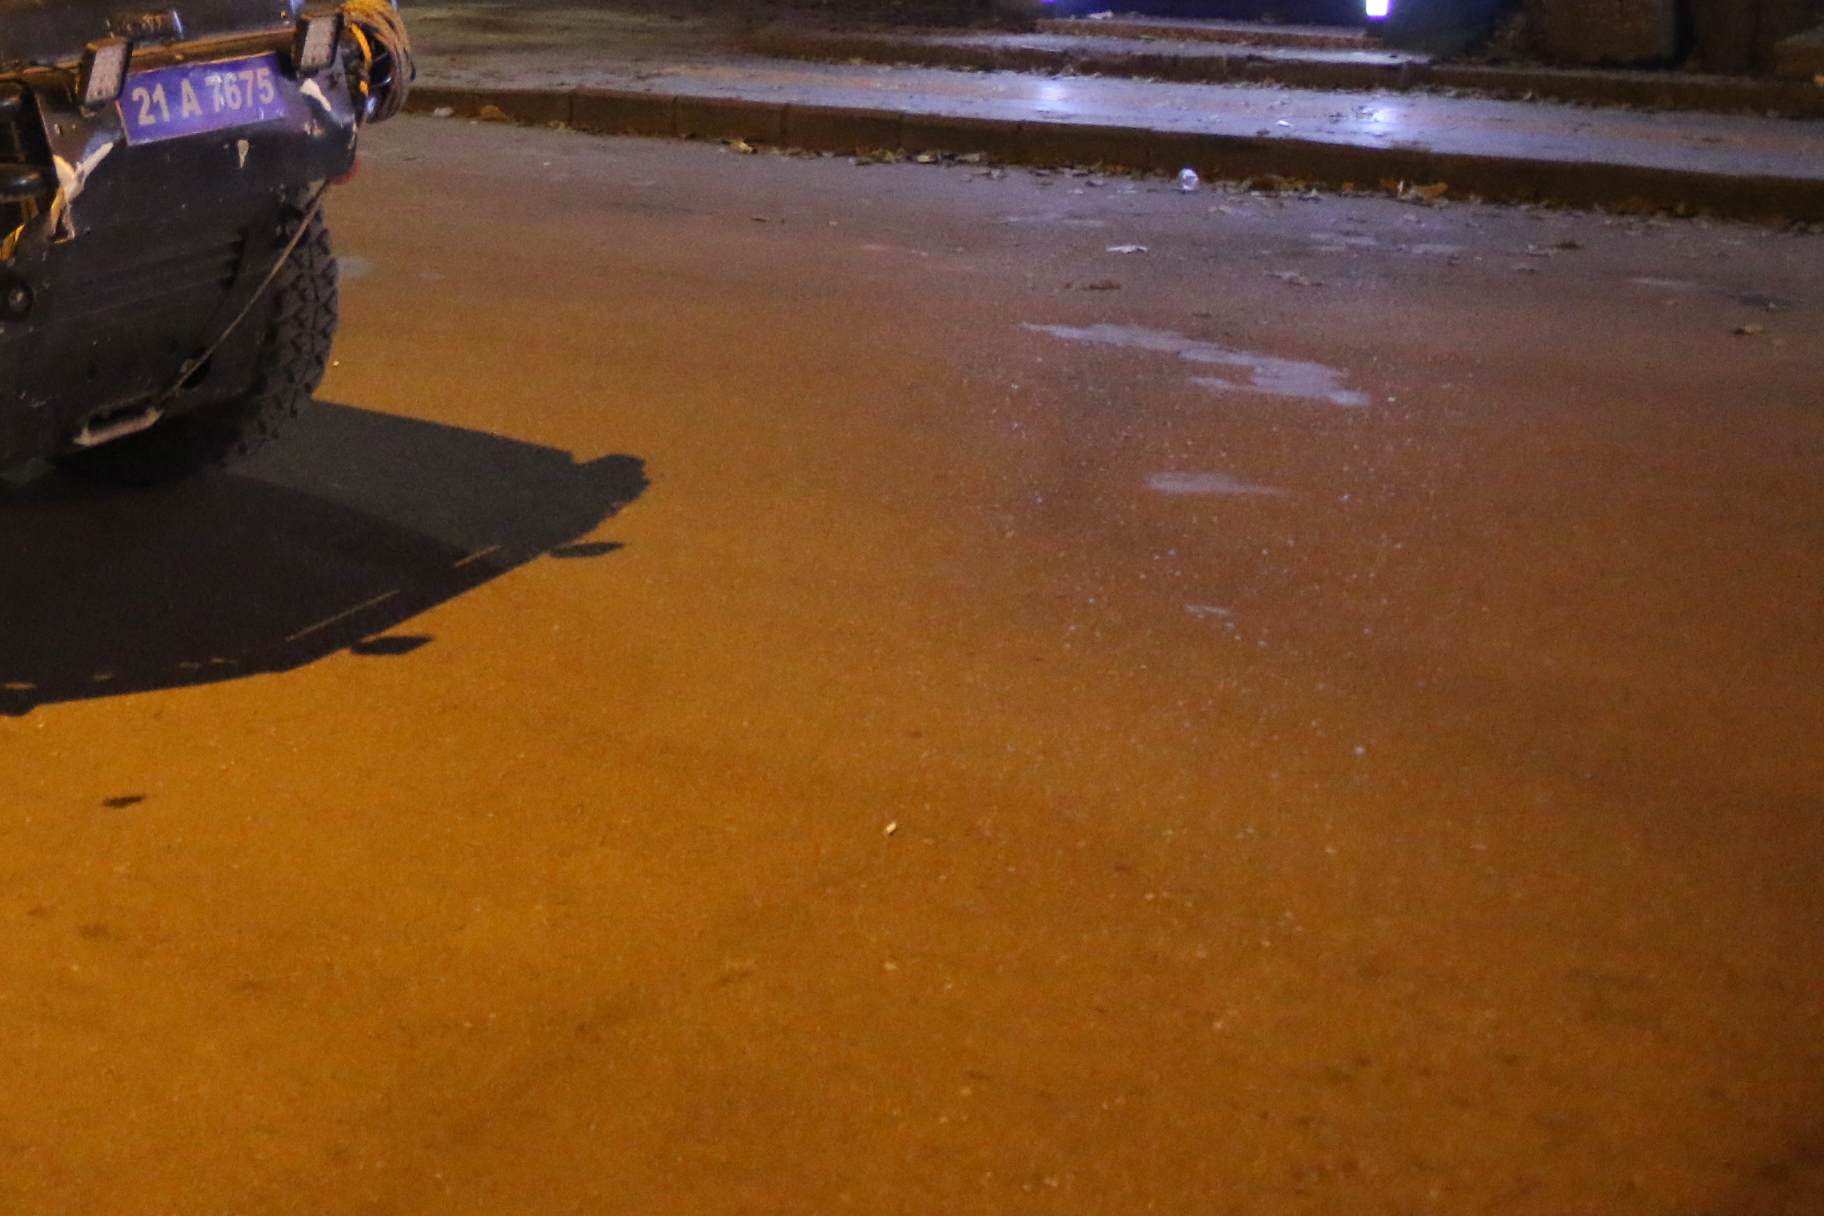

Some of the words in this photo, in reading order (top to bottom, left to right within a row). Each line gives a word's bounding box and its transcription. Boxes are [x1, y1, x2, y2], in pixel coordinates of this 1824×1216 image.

[132, 83, 170, 126] 21
[181, 78, 202, 118] A
[205, 67, 275, 113] 7675
